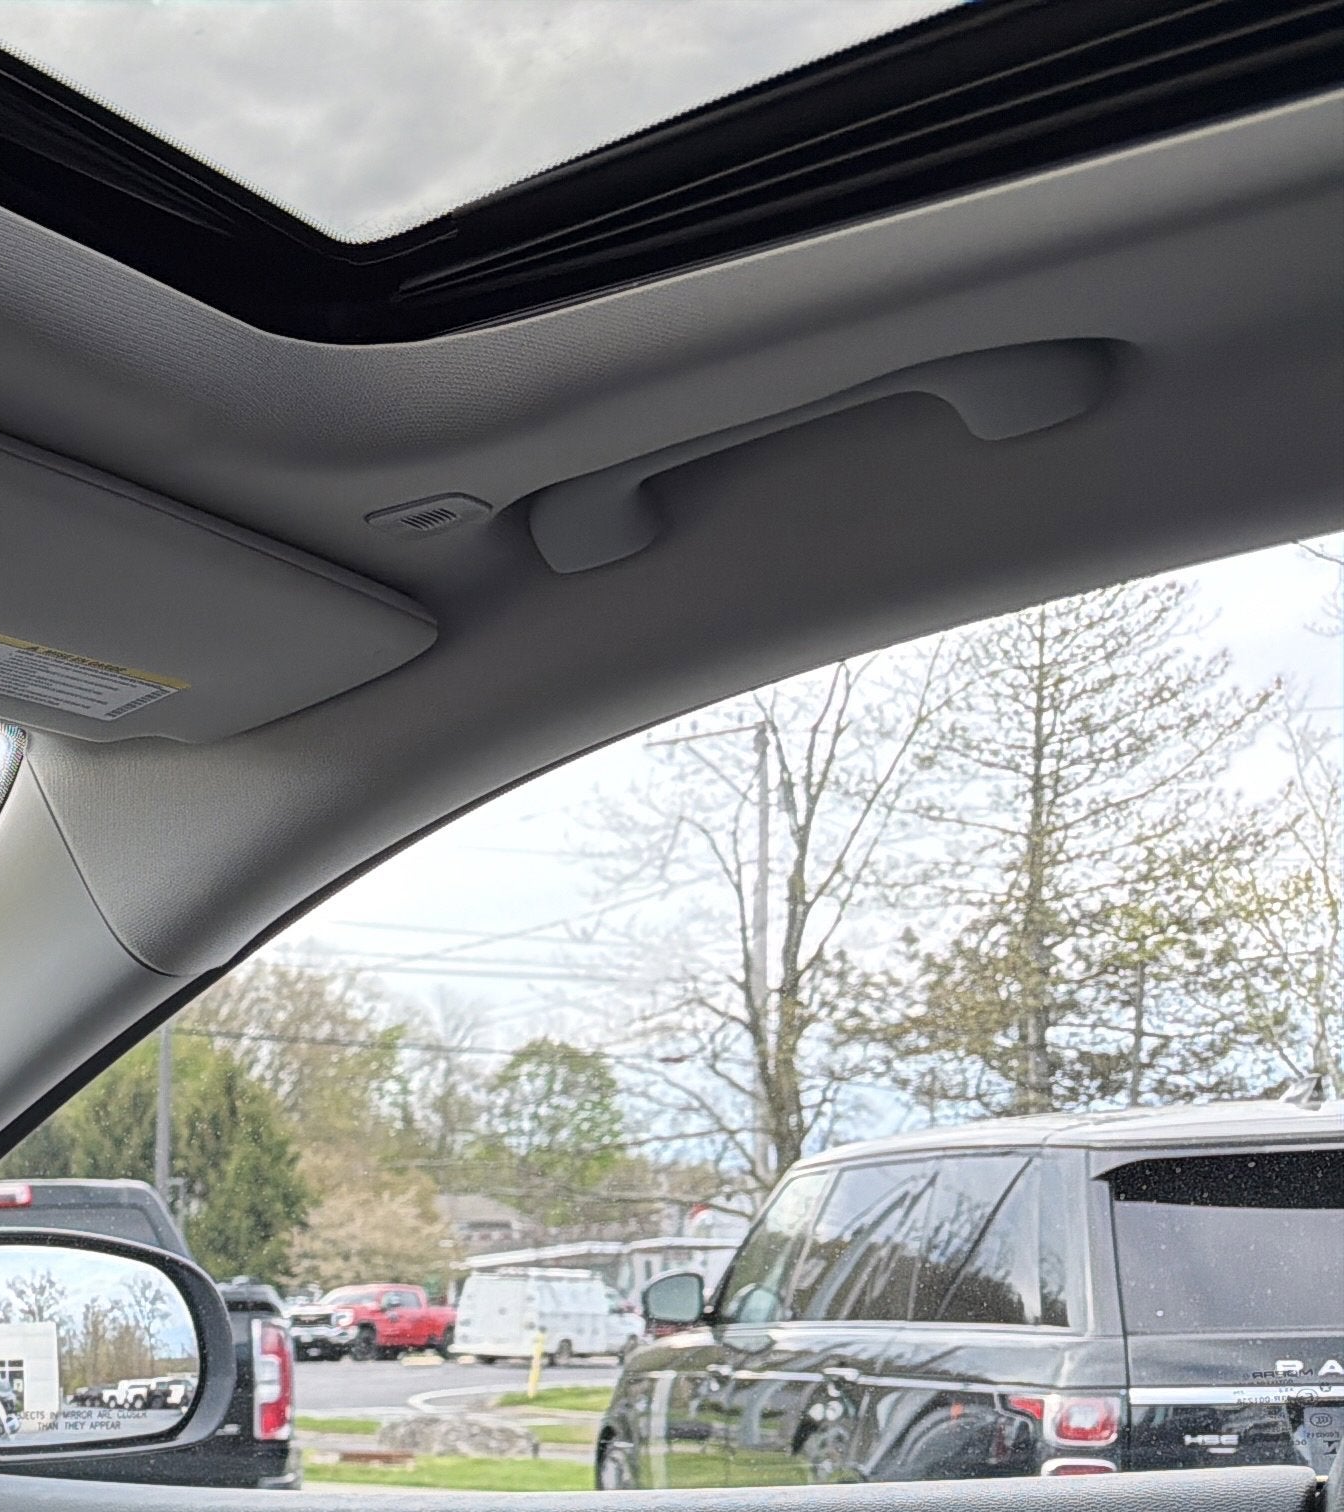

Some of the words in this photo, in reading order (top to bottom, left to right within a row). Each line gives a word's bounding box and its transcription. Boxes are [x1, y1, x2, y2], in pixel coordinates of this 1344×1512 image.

[63, 1410, 93, 1420] MIRROR
[97, 1410, 112, 1419] ARE
[117, 1410, 147, 1419] CLOSER
[37, 1422, 59, 1431] THAN
[65, 1421, 85, 1430] THEY
[89, 1421, 121, 1430] APPEAR
